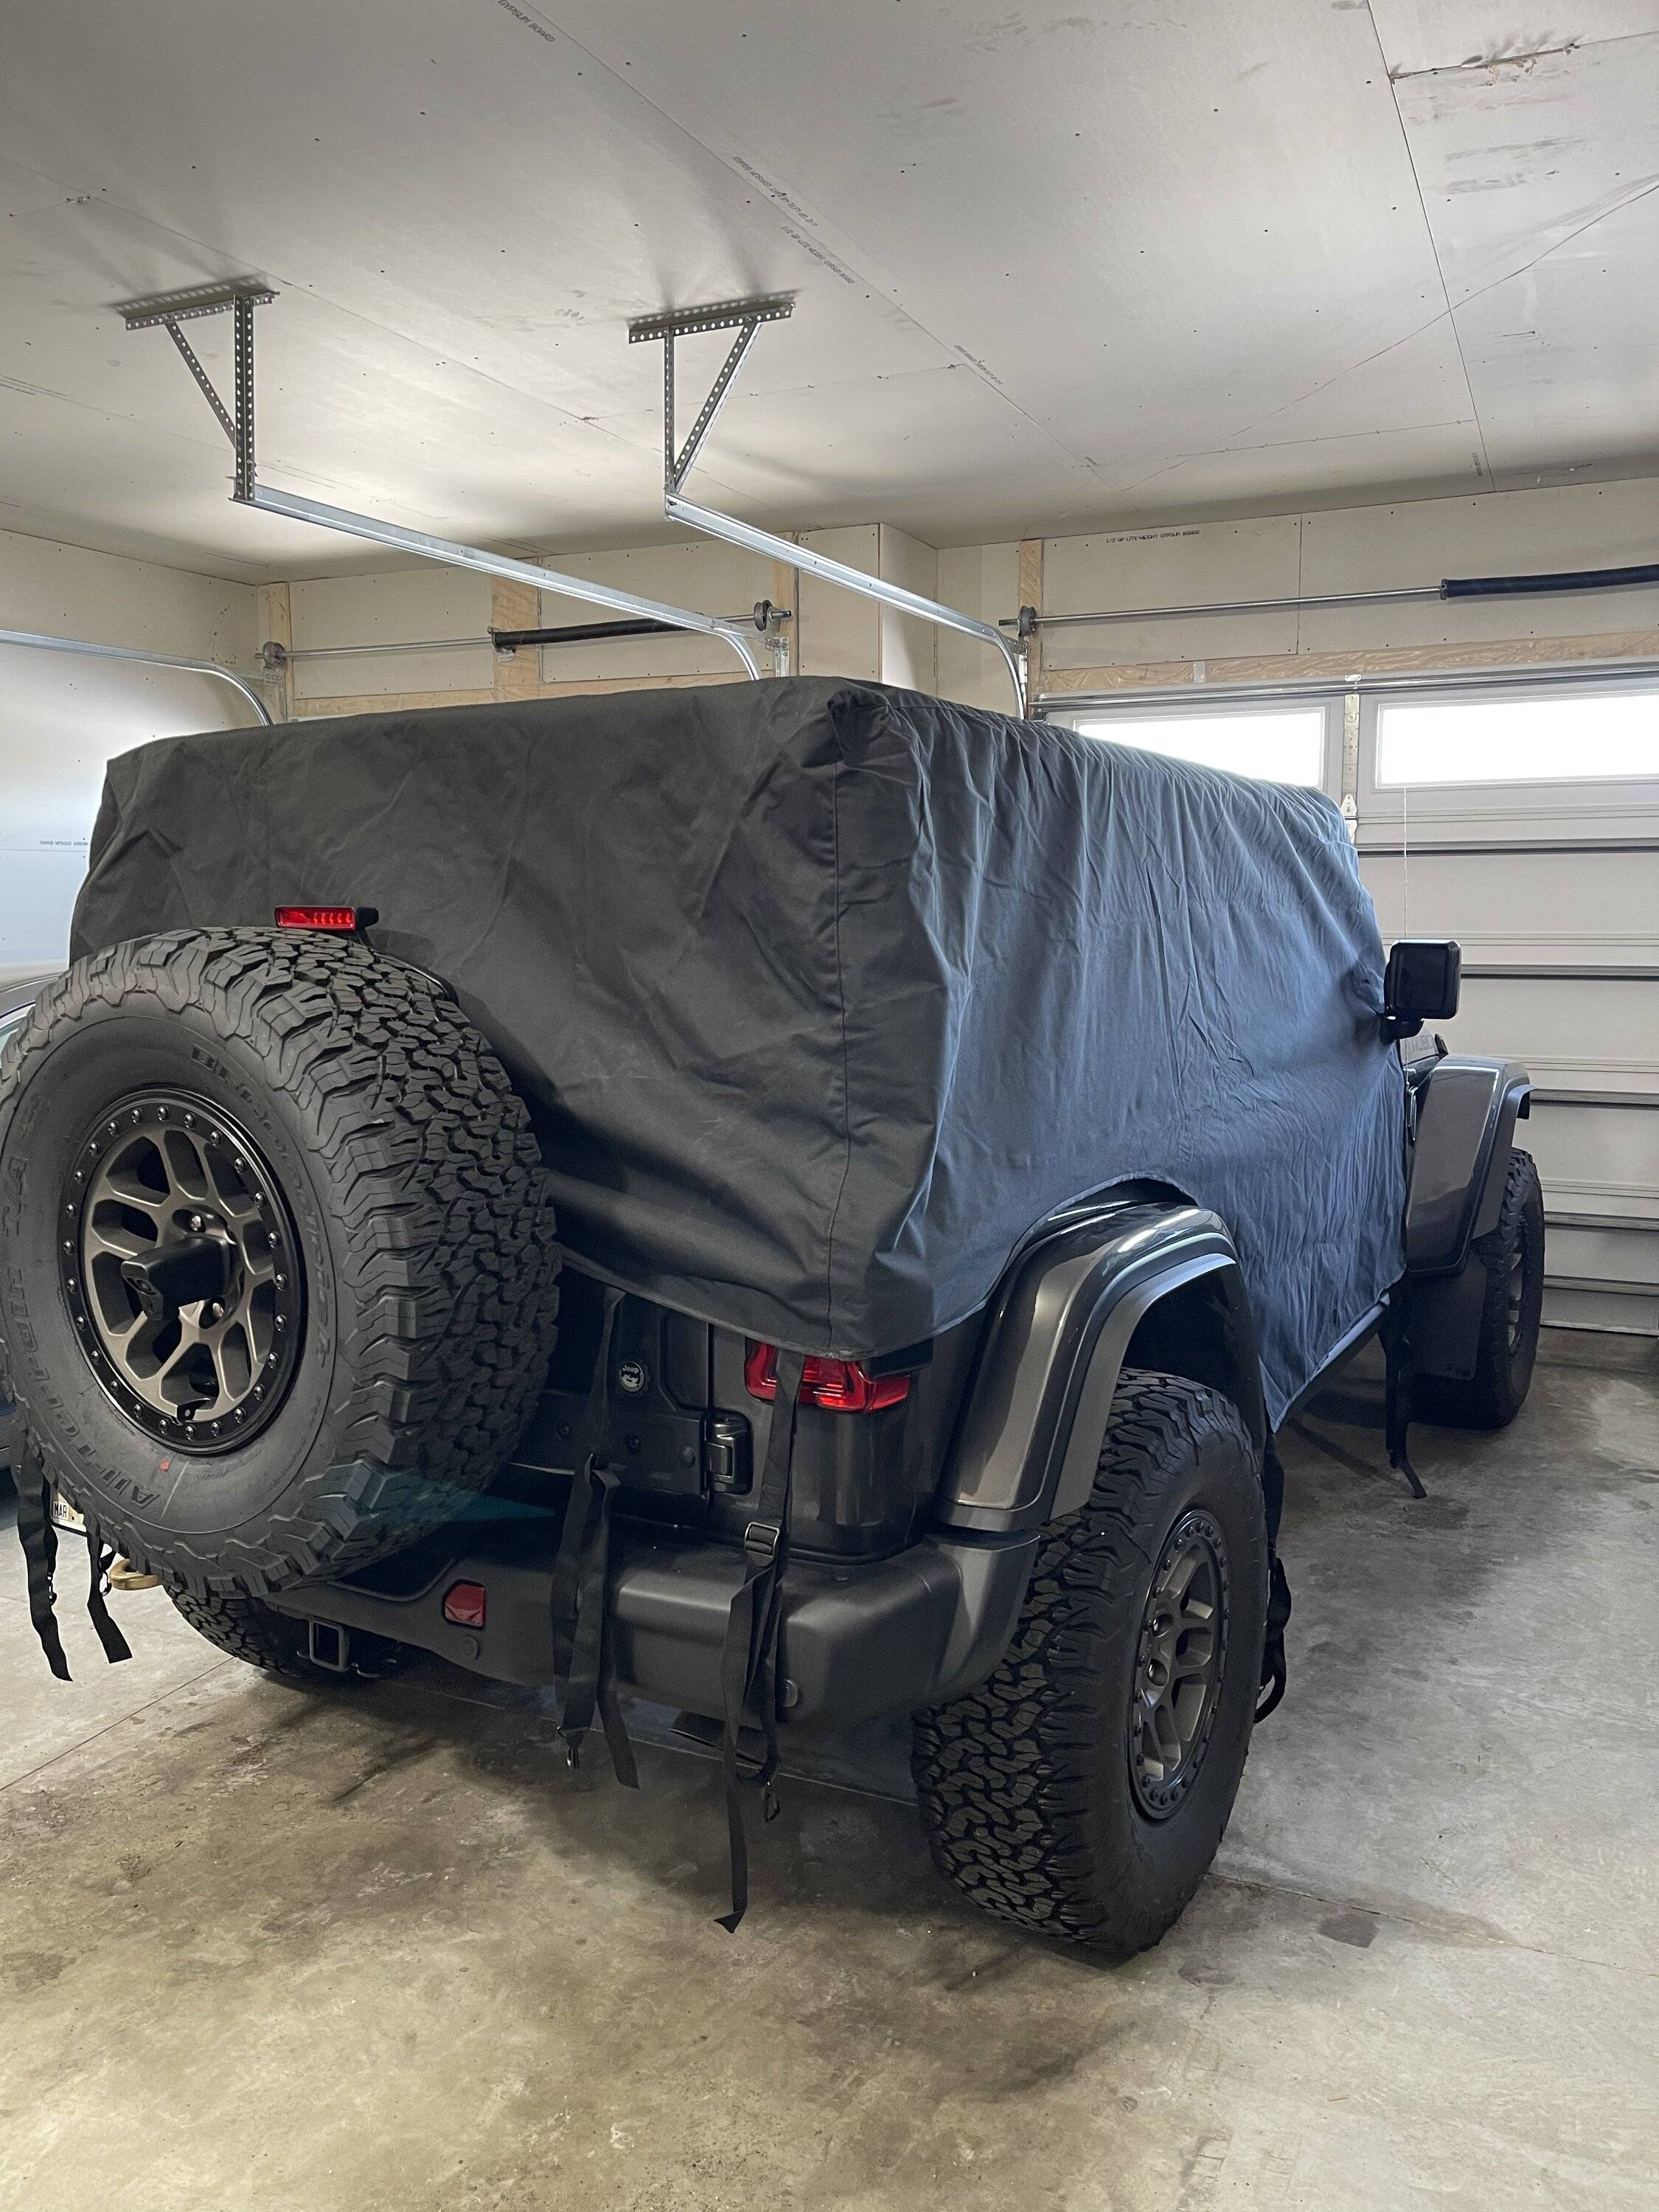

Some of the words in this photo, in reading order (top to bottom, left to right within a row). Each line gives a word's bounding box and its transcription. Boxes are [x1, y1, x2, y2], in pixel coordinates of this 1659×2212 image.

[497, 0, 531, 23] GYPSUM
[528, 23, 555, 42] BOARD
[54, 1502, 67, 1518] MAR
